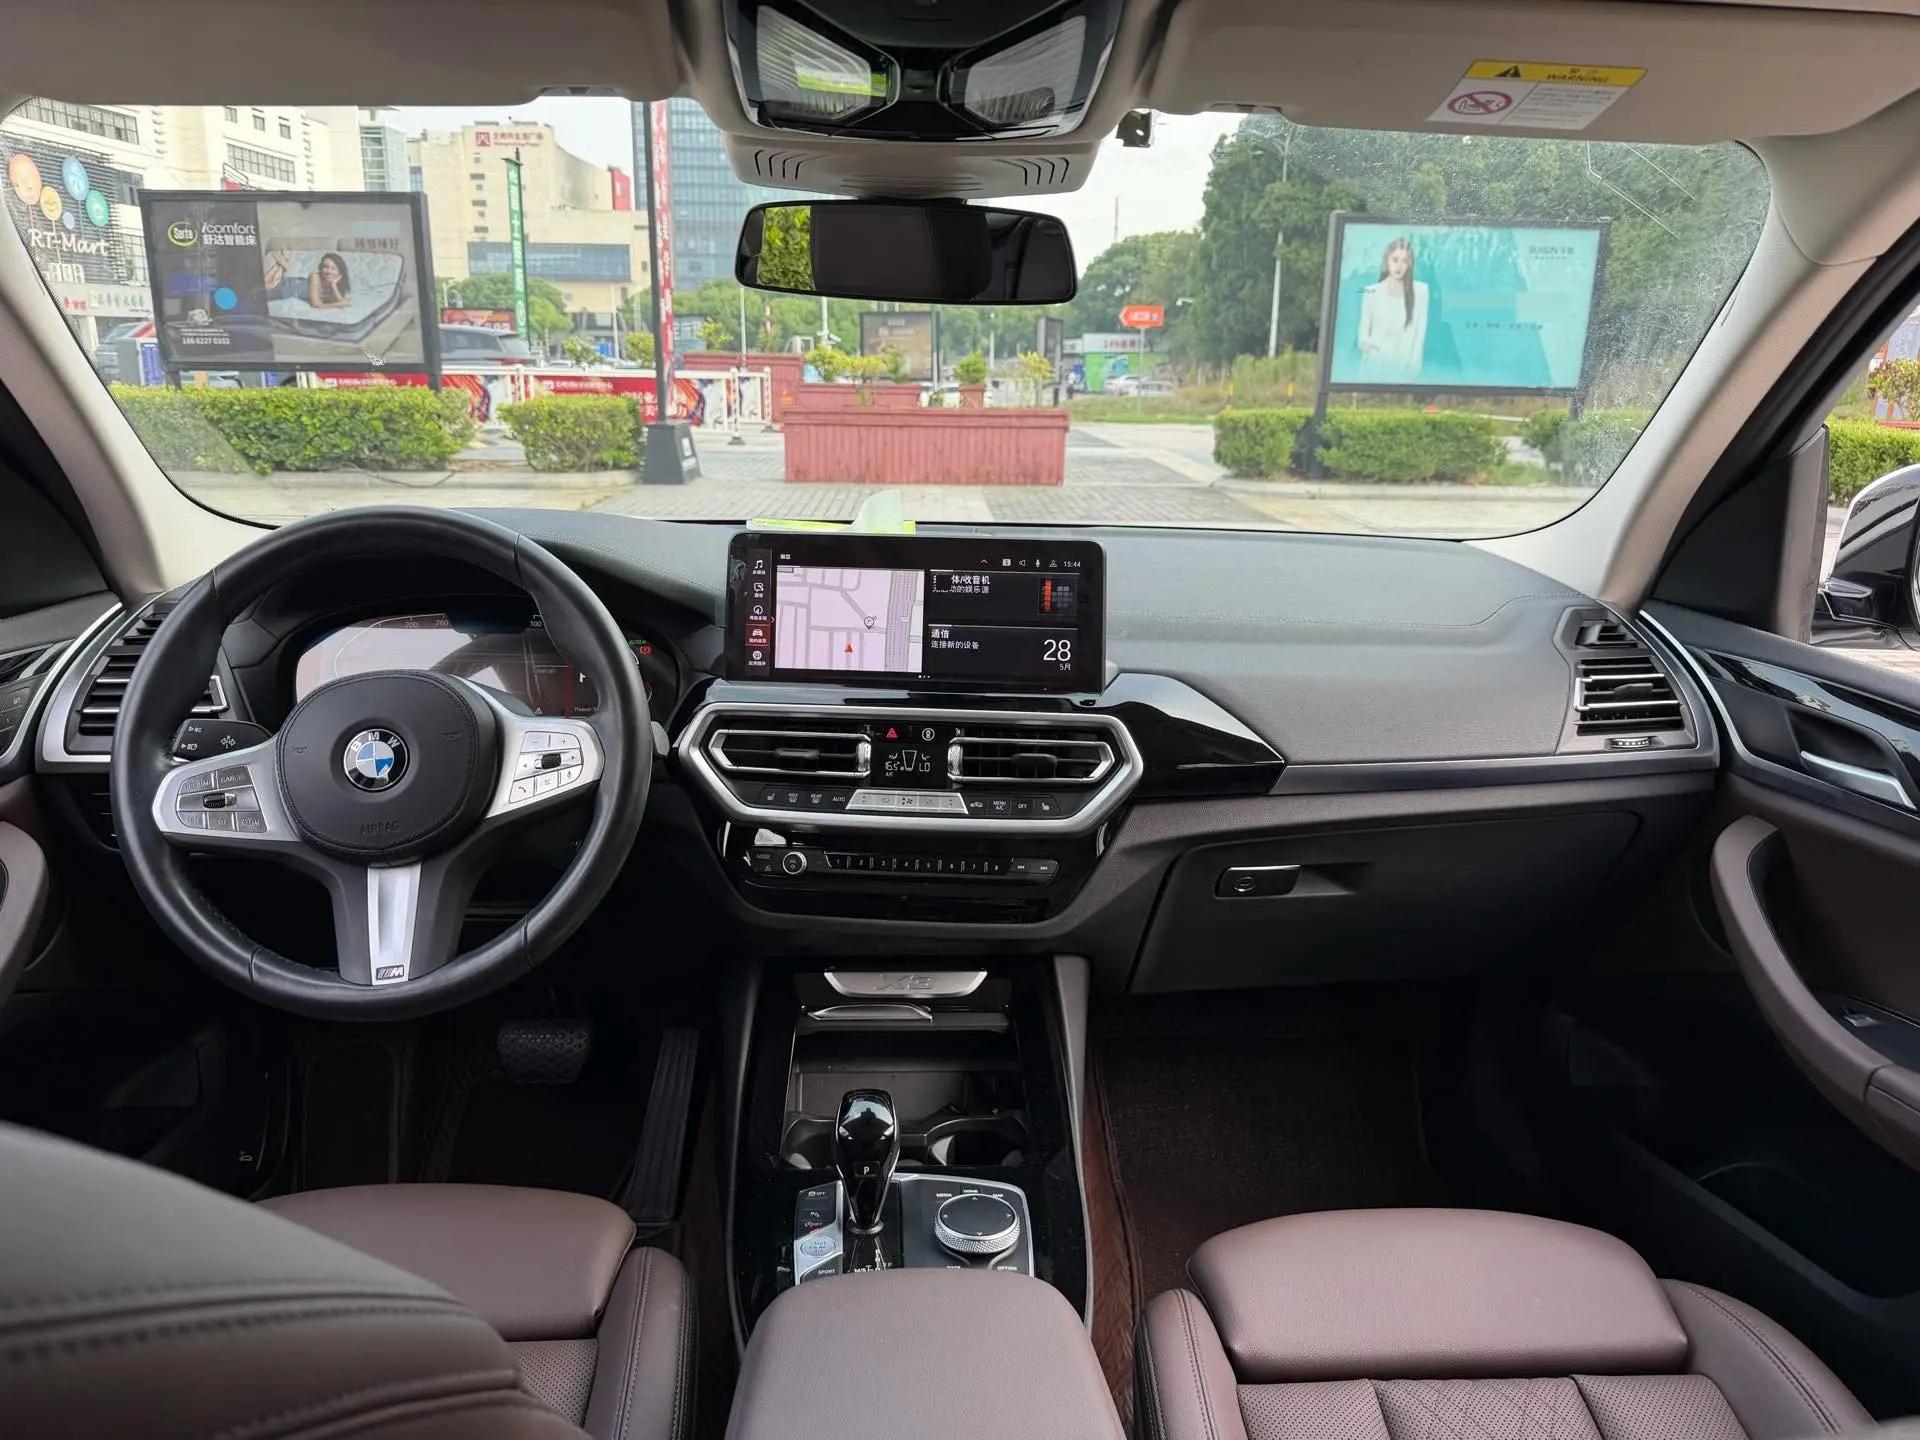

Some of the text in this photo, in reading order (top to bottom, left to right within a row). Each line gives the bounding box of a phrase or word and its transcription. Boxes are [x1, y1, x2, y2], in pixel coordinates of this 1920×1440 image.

[1546, 73, 1609, 83] WARNING
[28, 228, 110, 256] RT-Mart
[530, 620, 543, 628] 100
[931, 629, 950, 638] 通信
[1043, 639, 1071, 661] 28
[1059, 663, 1071, 671] 5月
[351, 731, 400, 752] BMW
[360, 820, 400, 836] AIRBAG
[873, 975, 934, 991] X3
[863, 1165, 870, 1175] P
